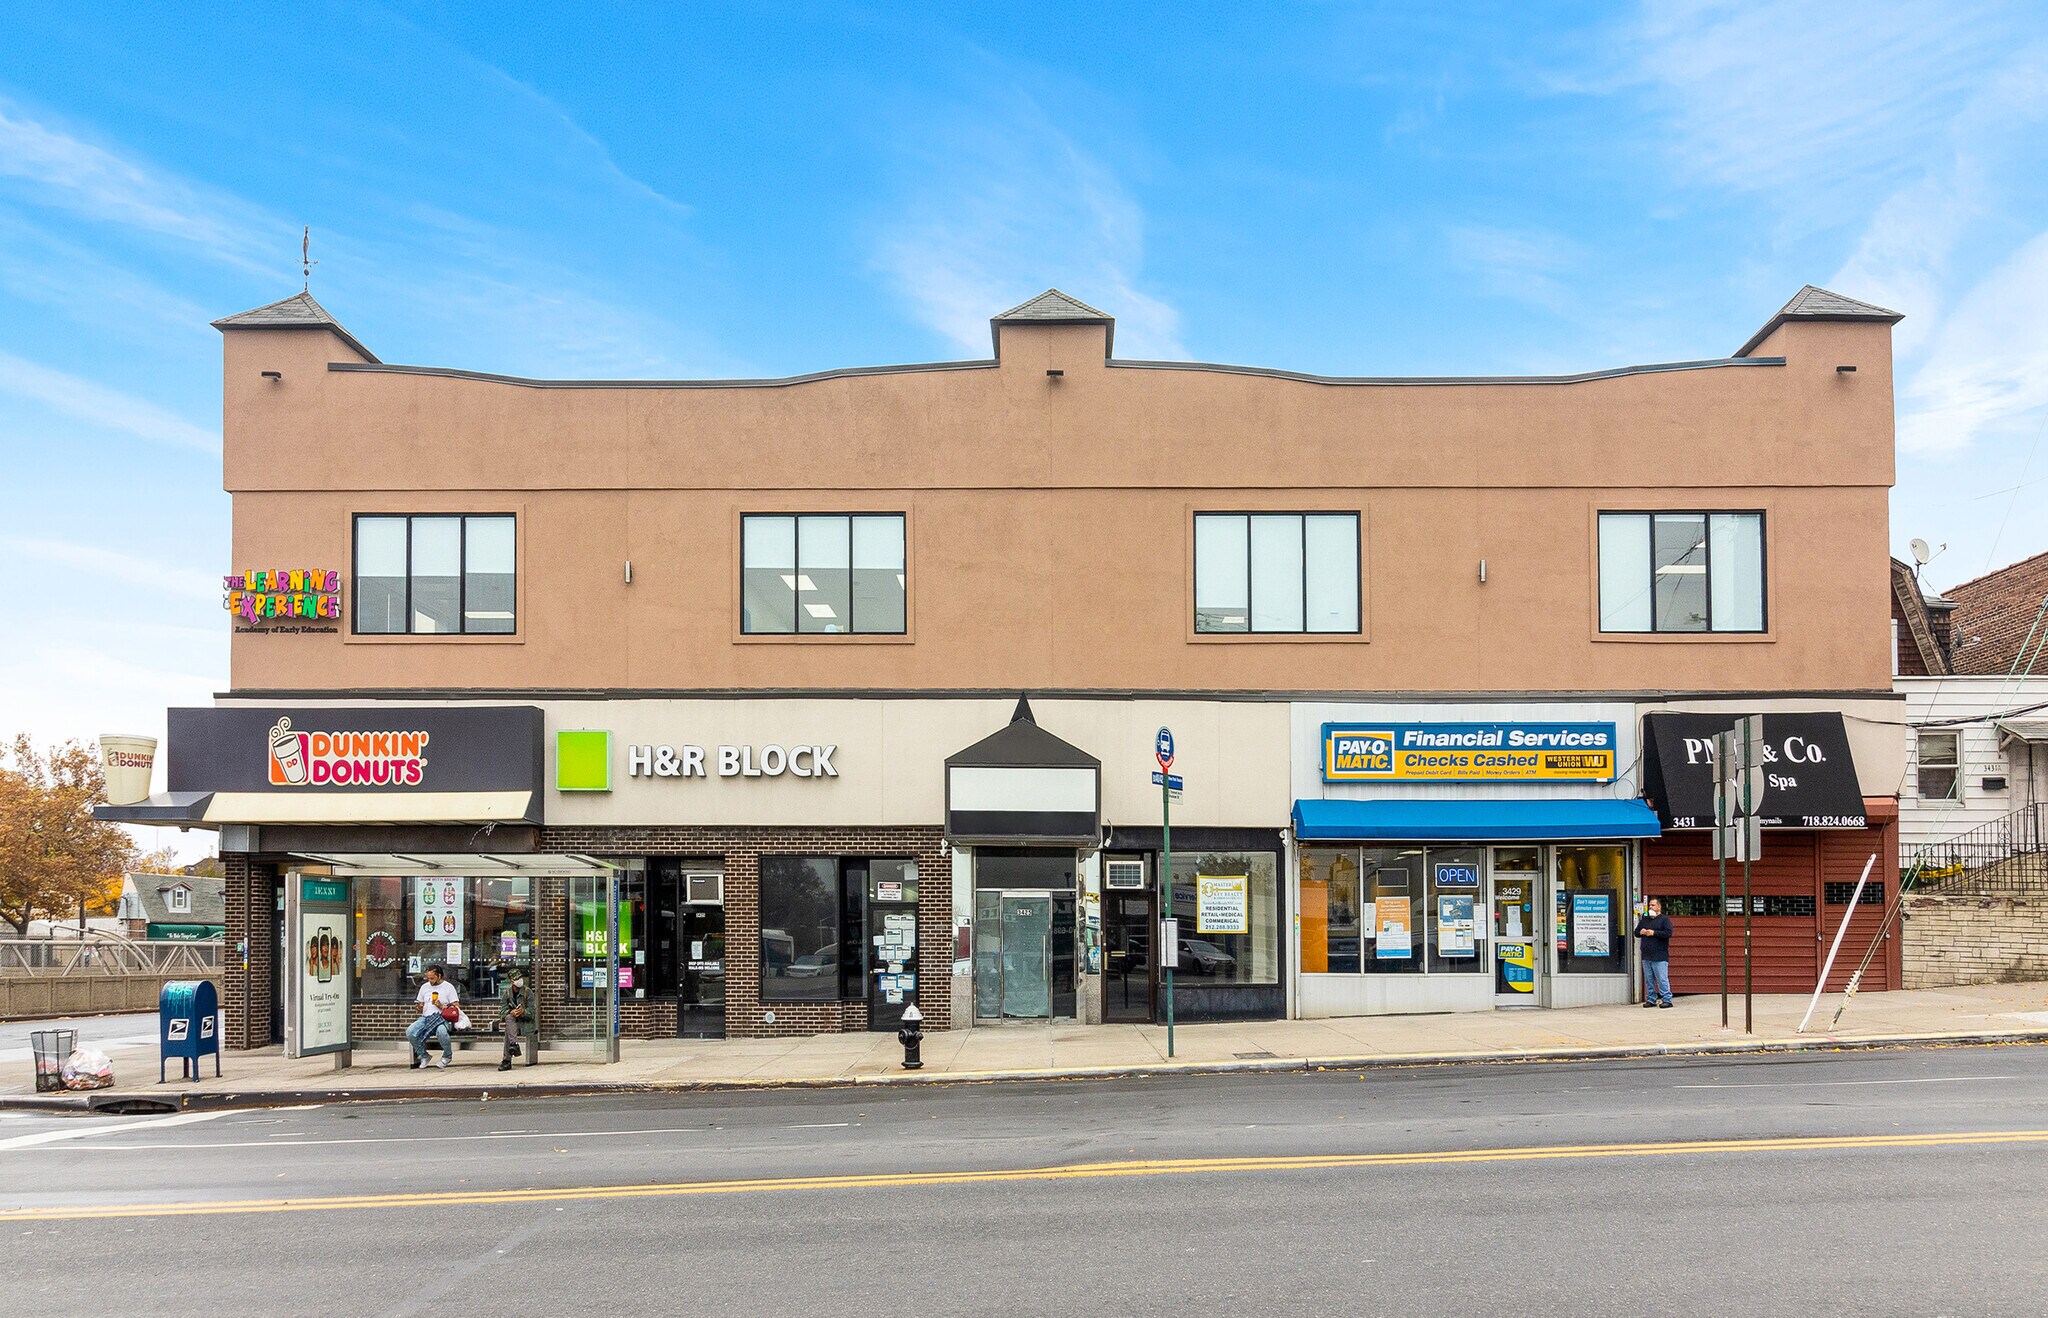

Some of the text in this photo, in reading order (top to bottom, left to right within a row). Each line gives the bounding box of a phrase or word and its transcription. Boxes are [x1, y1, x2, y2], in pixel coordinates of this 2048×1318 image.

[224, 576, 245, 589] THE
[235, 626, 338, 635] Academy of Early Education
[1403, 729, 1608, 747] Financial Services
[312, 733, 428, 758] DUNKIN'
[1783, 736, 1827, 763] Co.
[628, 744, 840, 779] H&R BLOCK
[1405, 753, 1539, 767] Checks Cashed
[313, 759, 422, 784] DONUTS
[1768, 773, 1798, 791] Spa
[1673, 816, 1696, 828] 3431
[1802, 815, 1866, 827] 718.824.0668
[1439, 868, 1475, 883] OPEN
[1502, 887, 1522, 896] 3429
[425, 895, 434, 903] $3
[445, 895, 454, 903] $4
[365, 931, 381, 946] HAPPY
[388, 935, 397, 946] SEE
[411, 958, 419, 969] A
[309, 992, 340, 1002] Virtual Try-On
